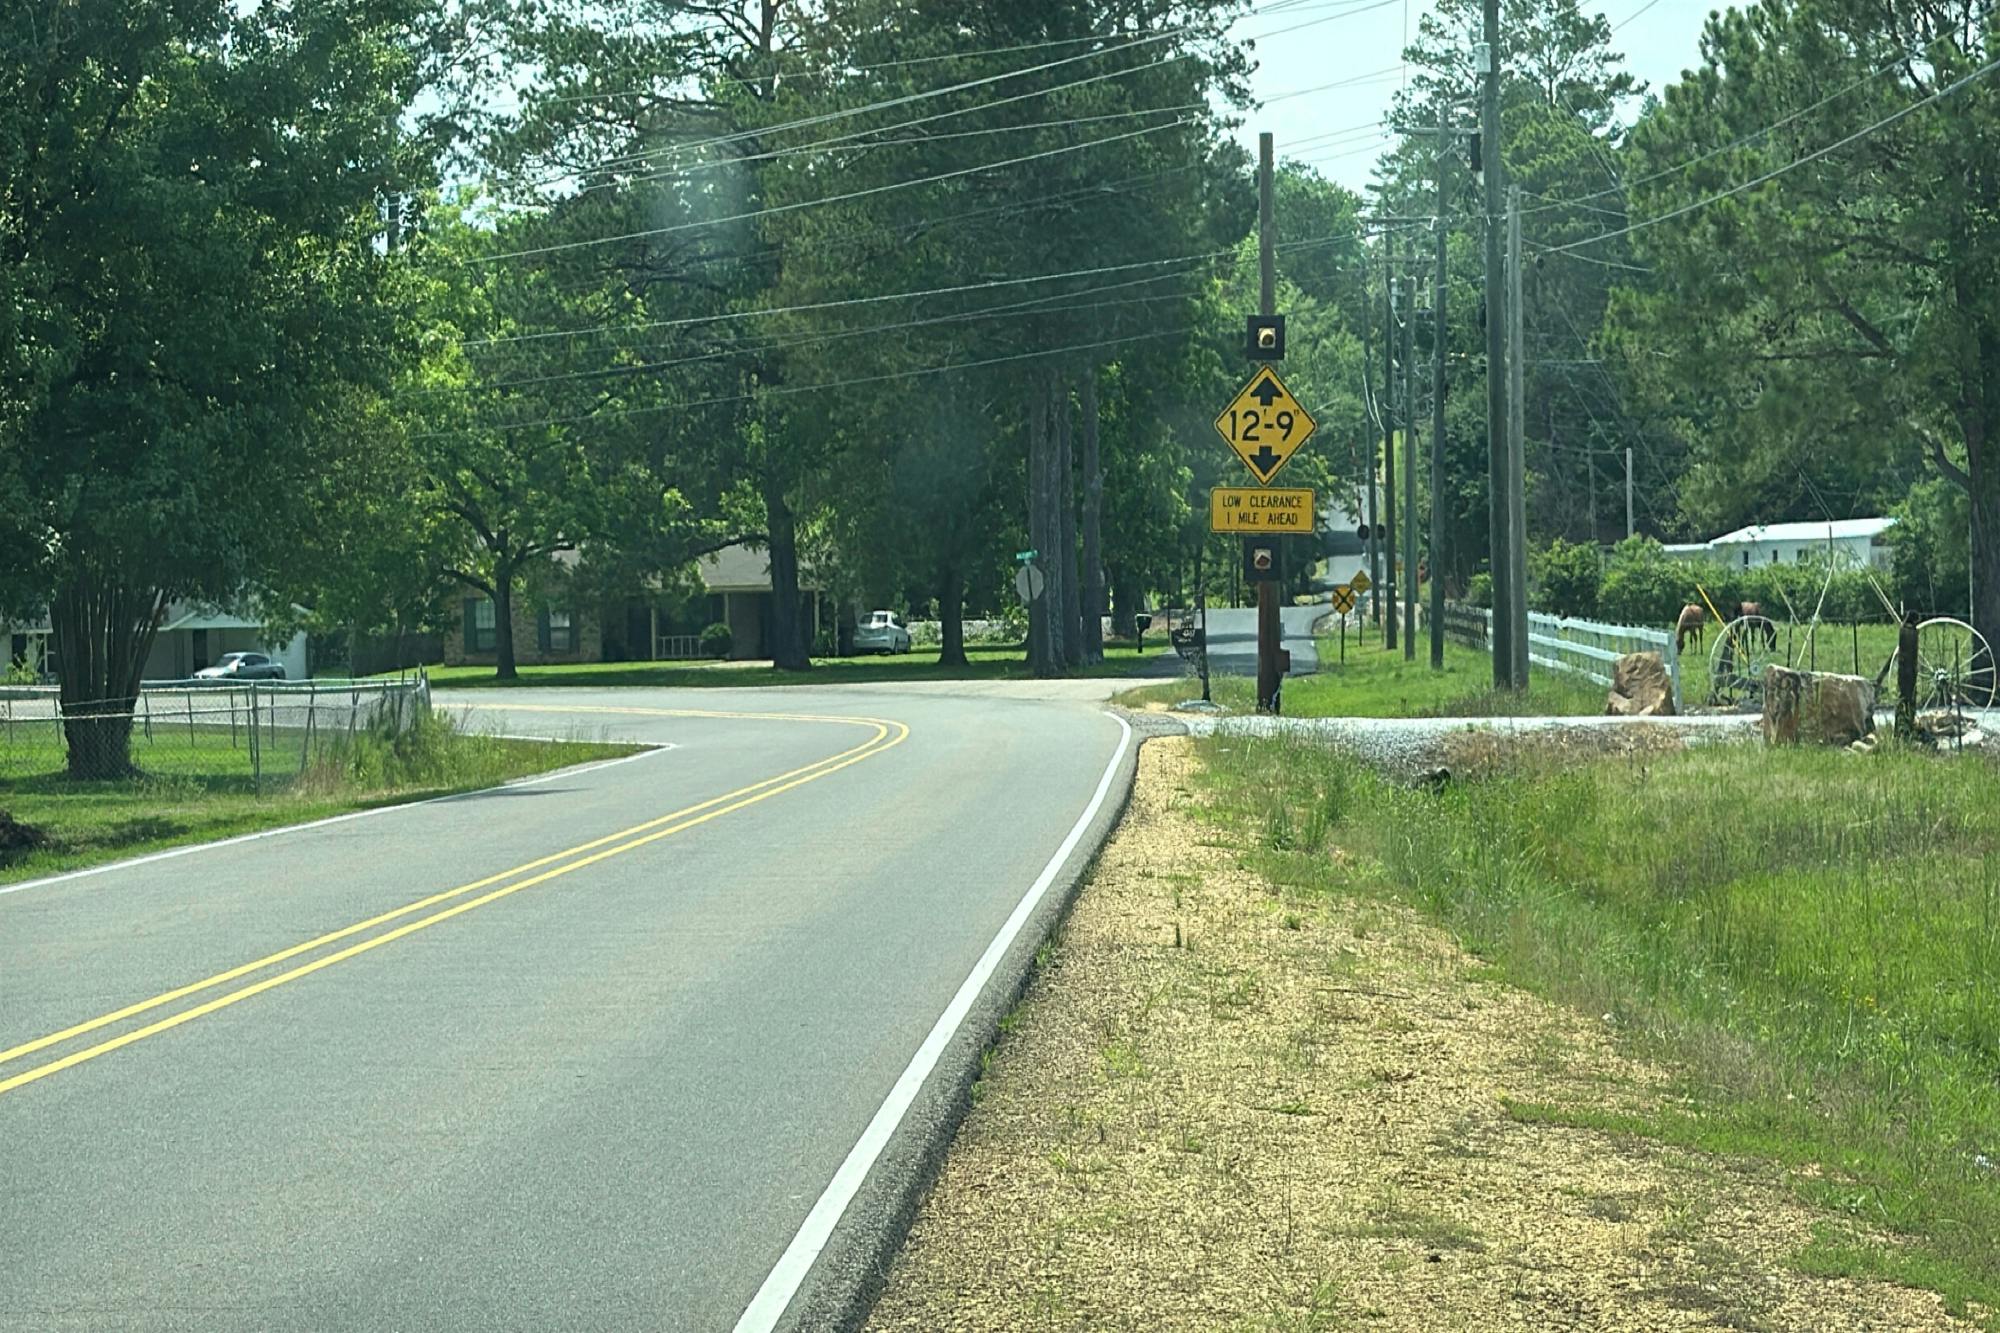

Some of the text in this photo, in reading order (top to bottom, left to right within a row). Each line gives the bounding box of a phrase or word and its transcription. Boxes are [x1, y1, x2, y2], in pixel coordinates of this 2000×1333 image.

[1222, 495, 1302, 509] LOW CLEARANCE
[1238, 512, 1259, 525] MILE
[1267, 512, 1298, 526] AHEAD
